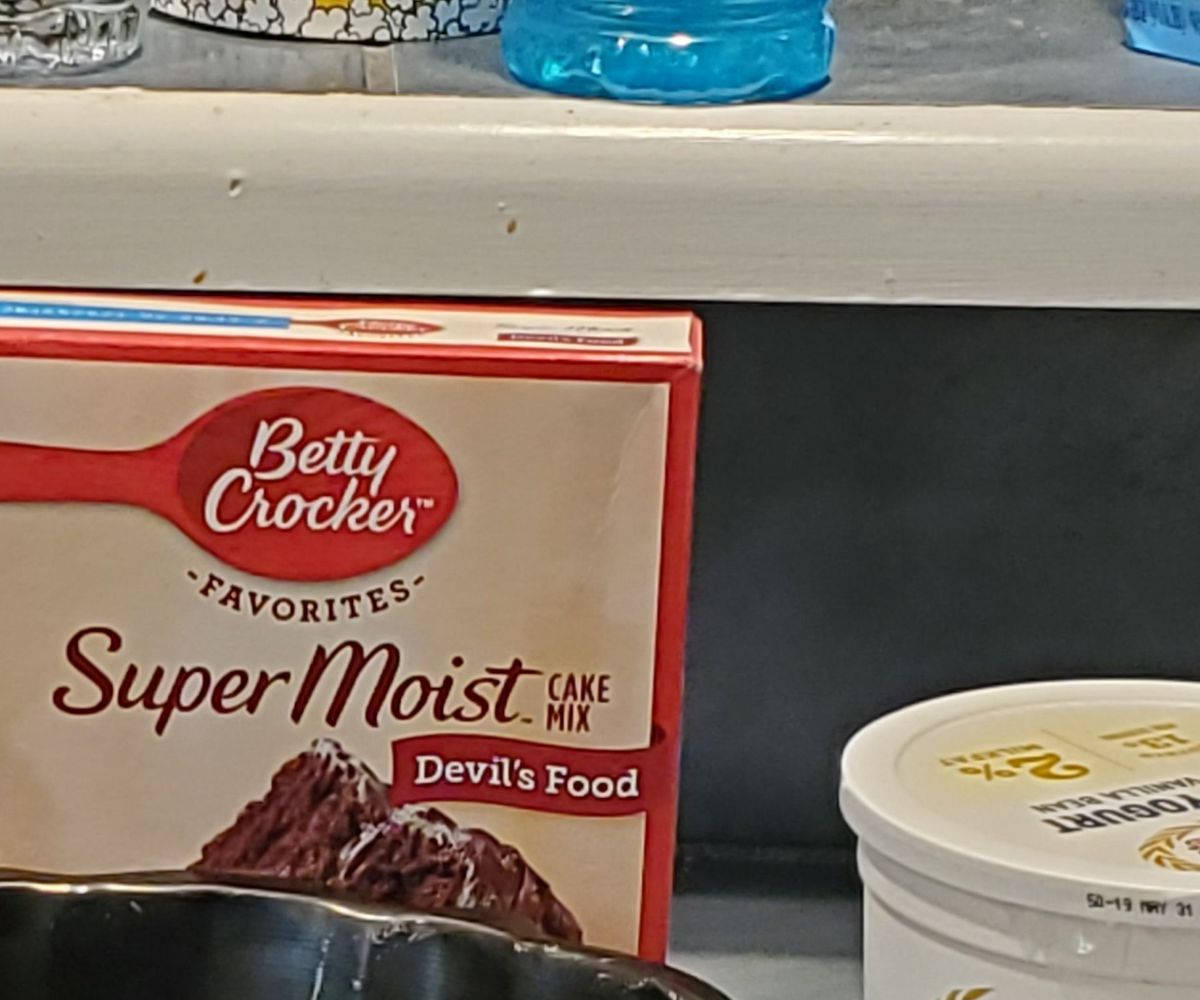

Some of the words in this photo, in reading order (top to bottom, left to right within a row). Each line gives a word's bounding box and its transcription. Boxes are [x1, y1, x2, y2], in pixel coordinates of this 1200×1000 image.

[250, 417, 397, 497] Betty
[204, 467, 414, 534] Crocker
[547, 673, 611, 703] CAKE
[546, 704, 591, 733] MIX
[415, 754, 536, 792] Devil's
[544, 763, 640, 799] Food
[958, 753, 1090, 780] 2%
[1030, 795, 1103, 813] BEAN
